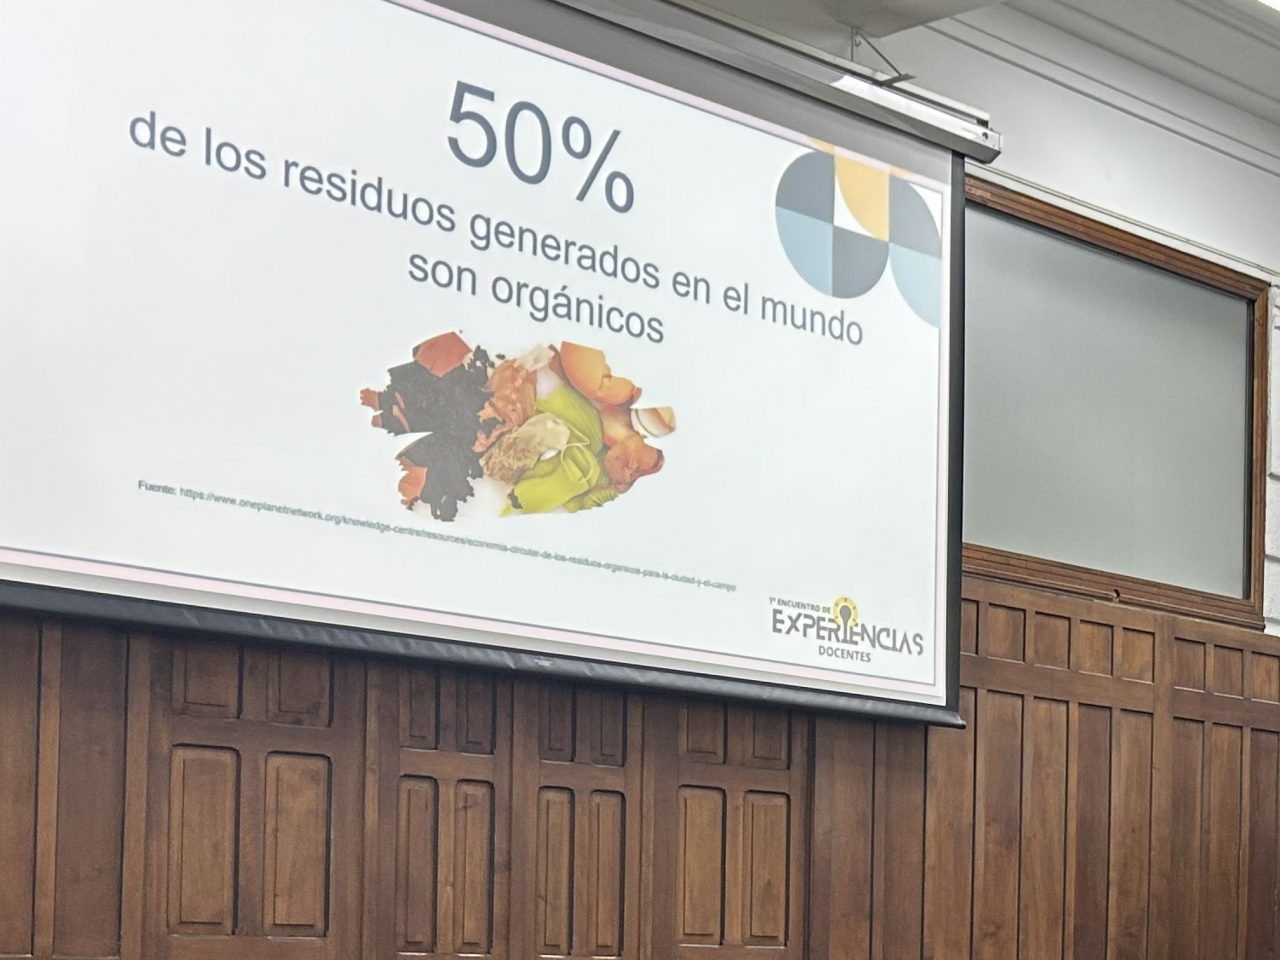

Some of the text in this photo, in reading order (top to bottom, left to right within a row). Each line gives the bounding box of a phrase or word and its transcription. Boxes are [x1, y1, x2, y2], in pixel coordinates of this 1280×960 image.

[447, 80, 635, 214] 50%
[129, 110, 863, 346] de los residuos generados en el mundo
[408, 253, 664, 344] son orgánicos
[137, 479, 177, 496] Fuente:
[772, 606, 924, 656] EXPERIENCIAS
[777, 598, 821, 612] ENCUENTRO
[822, 605, 831, 614] DE
[818, 645, 872, 663] DOCENTES
